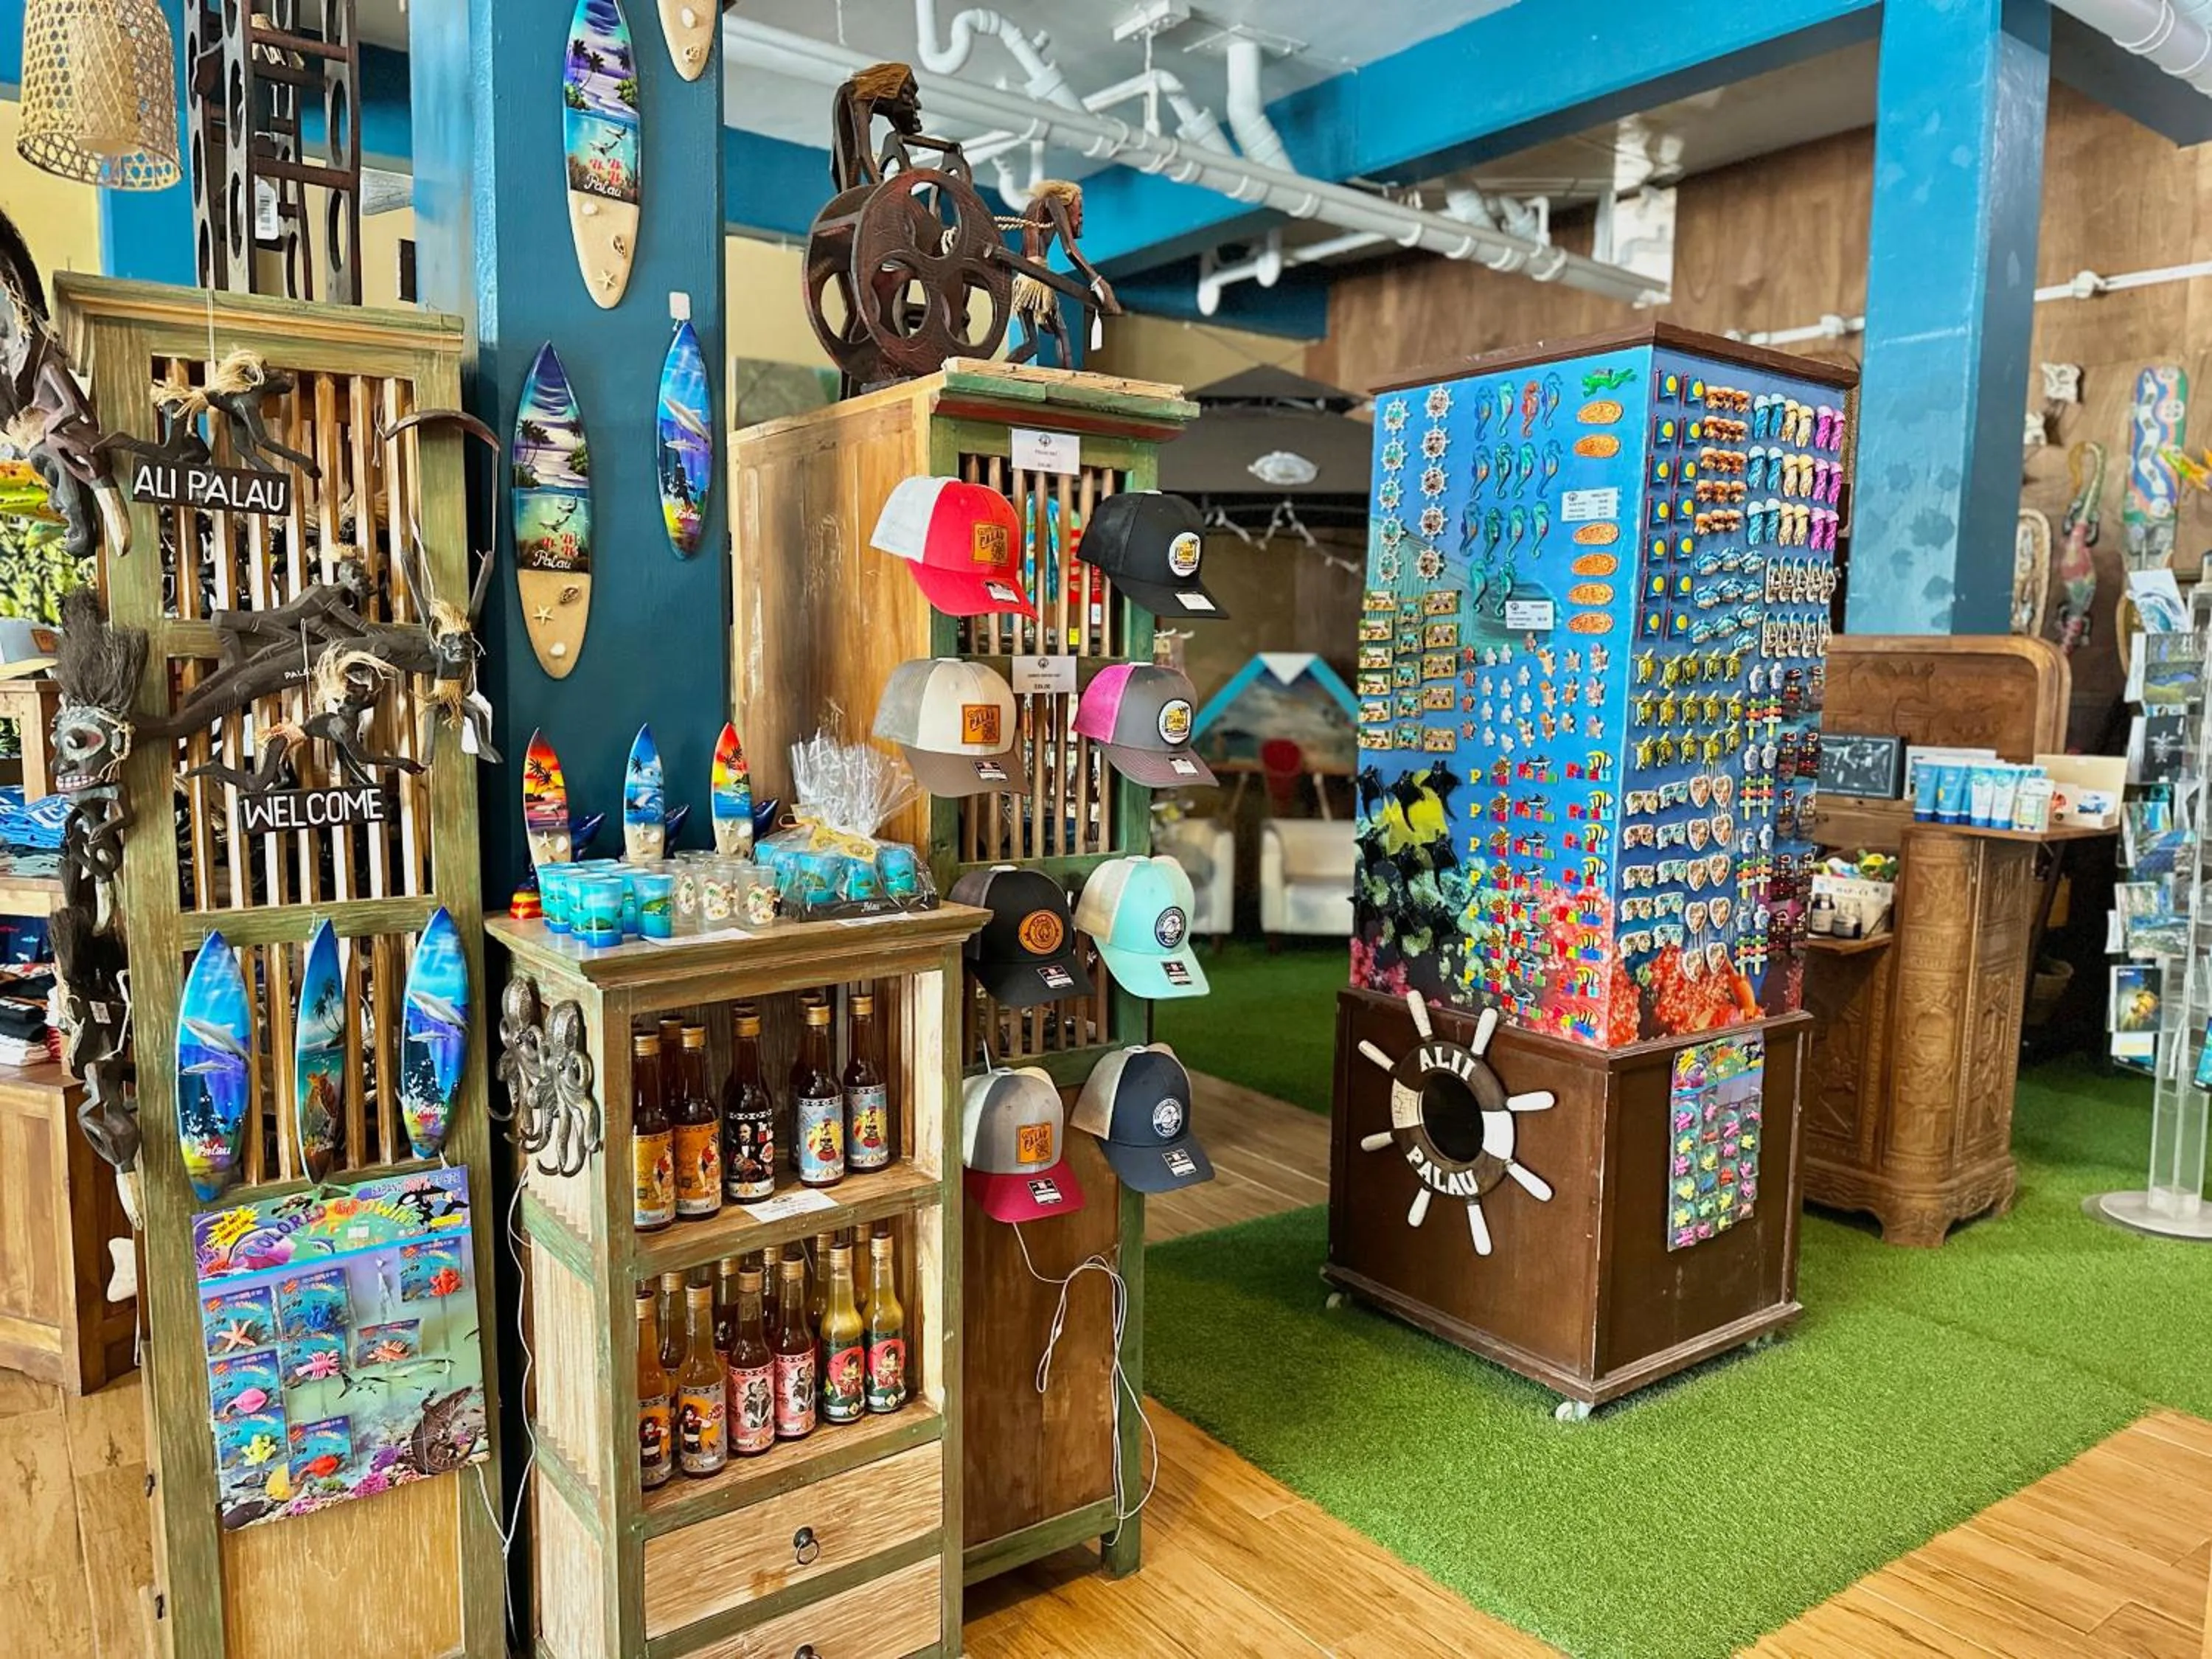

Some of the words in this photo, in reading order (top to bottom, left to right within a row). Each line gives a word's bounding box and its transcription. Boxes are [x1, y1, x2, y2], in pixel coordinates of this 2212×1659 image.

[584, 173, 622, 197] Palau
[133, 465, 176, 499] ALI
[188, 470, 285, 511] PALAU
[532, 549, 571, 569] Palau
[244, 789, 384, 830] WELCOME
[1419, 1046, 1475, 1081] ALII
[1406, 1144, 1478, 1196] PALAU
